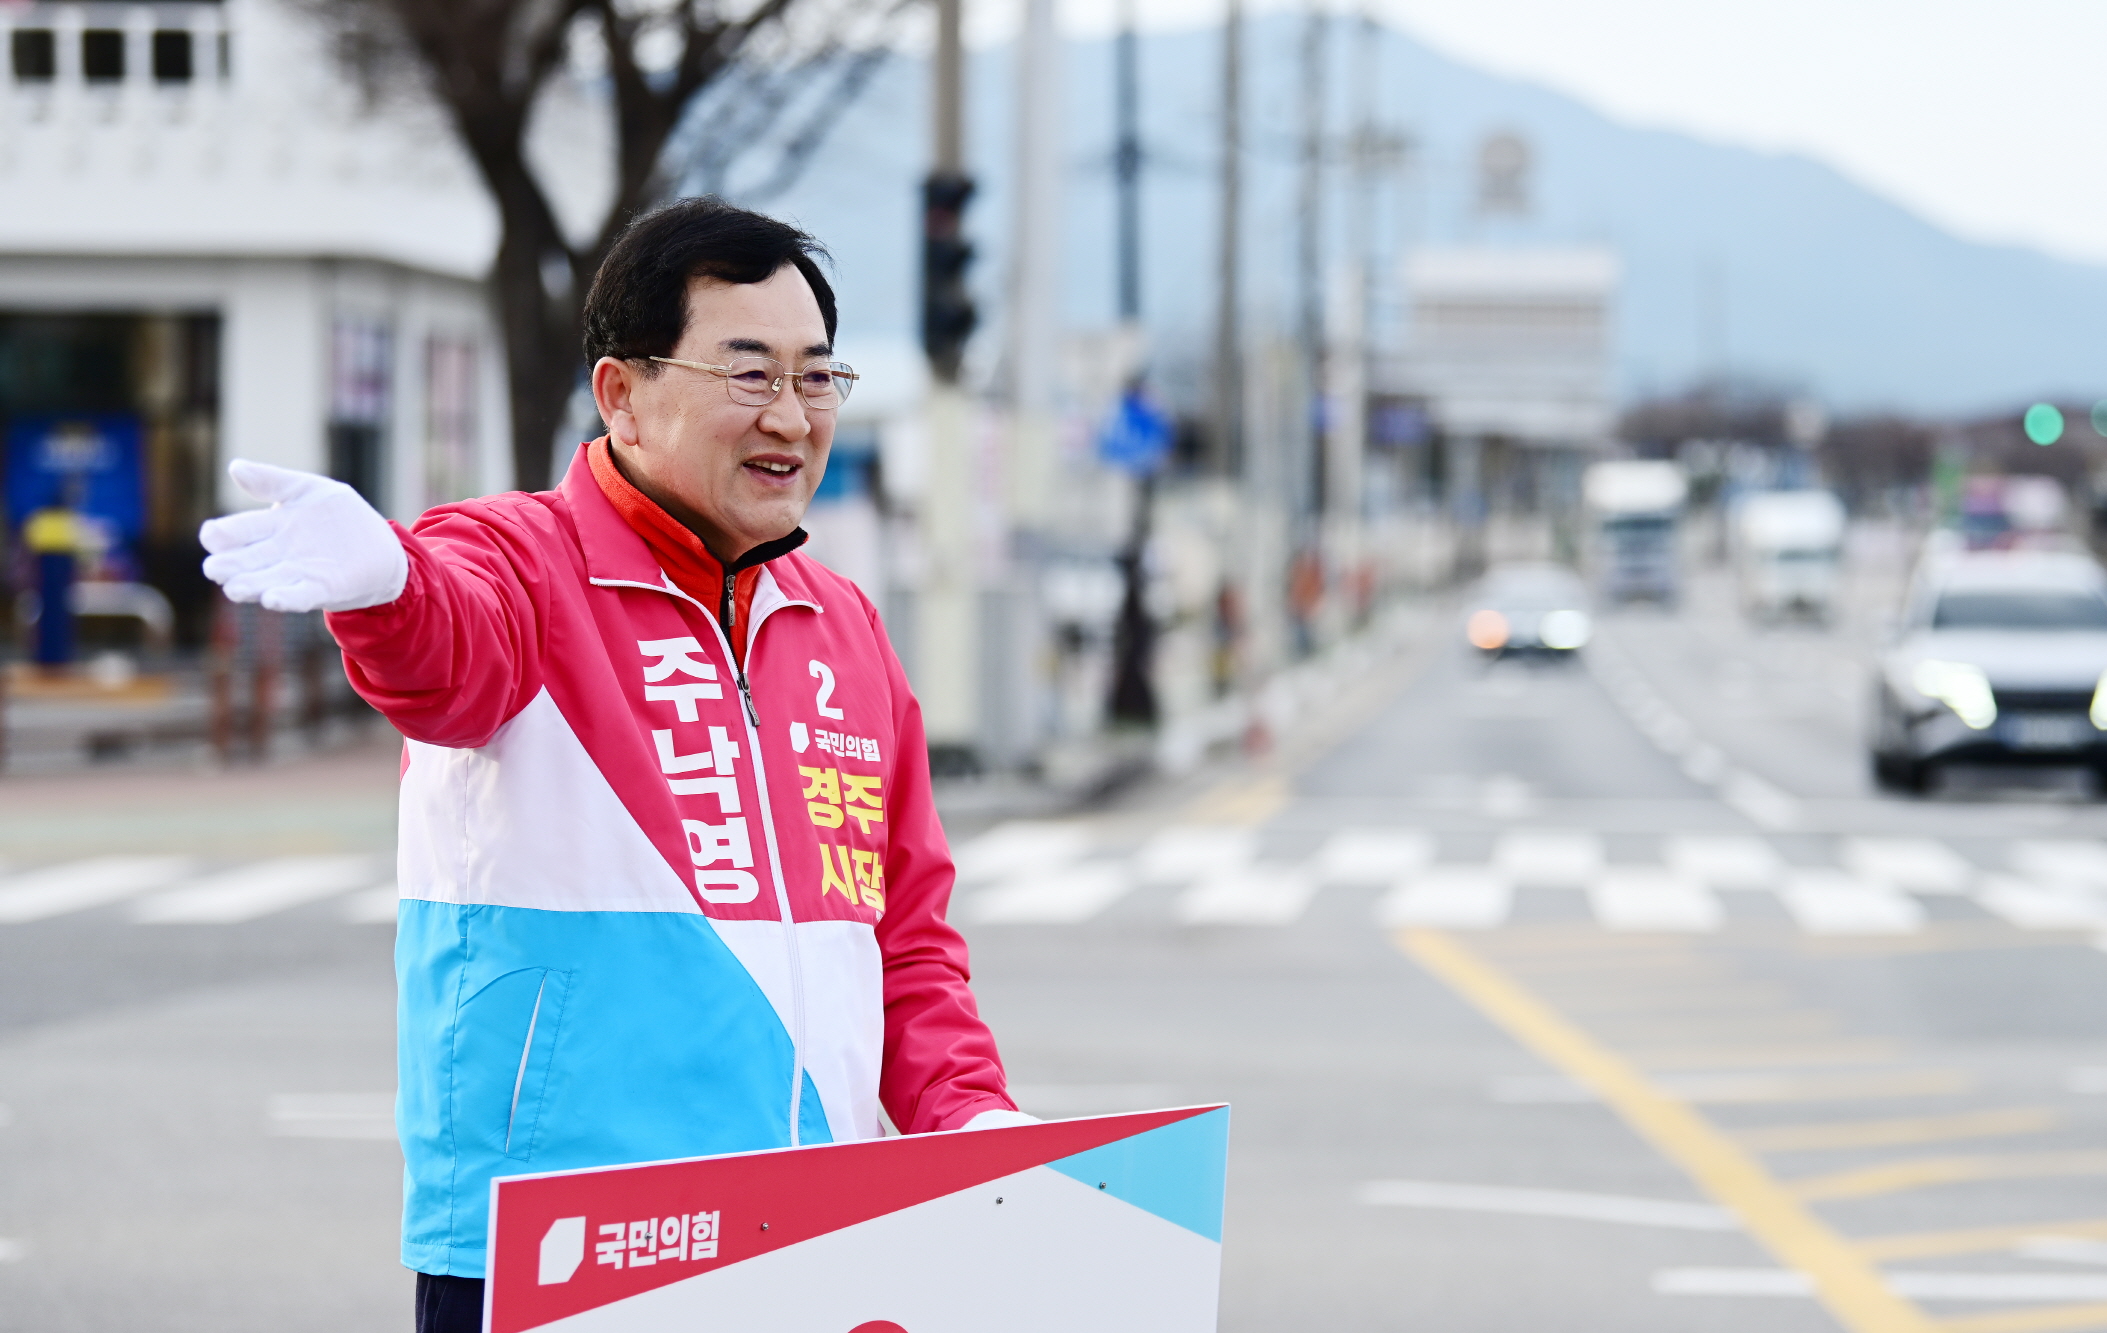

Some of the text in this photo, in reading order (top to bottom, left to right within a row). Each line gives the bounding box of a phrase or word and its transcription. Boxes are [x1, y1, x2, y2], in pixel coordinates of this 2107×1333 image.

[808, 659, 844, 721] 2
[636, 636, 760, 905] 주낙영
[814, 729, 882, 763] 국민의힘
[798, 765, 885, 835] 경주
[819, 842, 886, 912] 시장
[595, 1210, 720, 1270] 국민의힘
